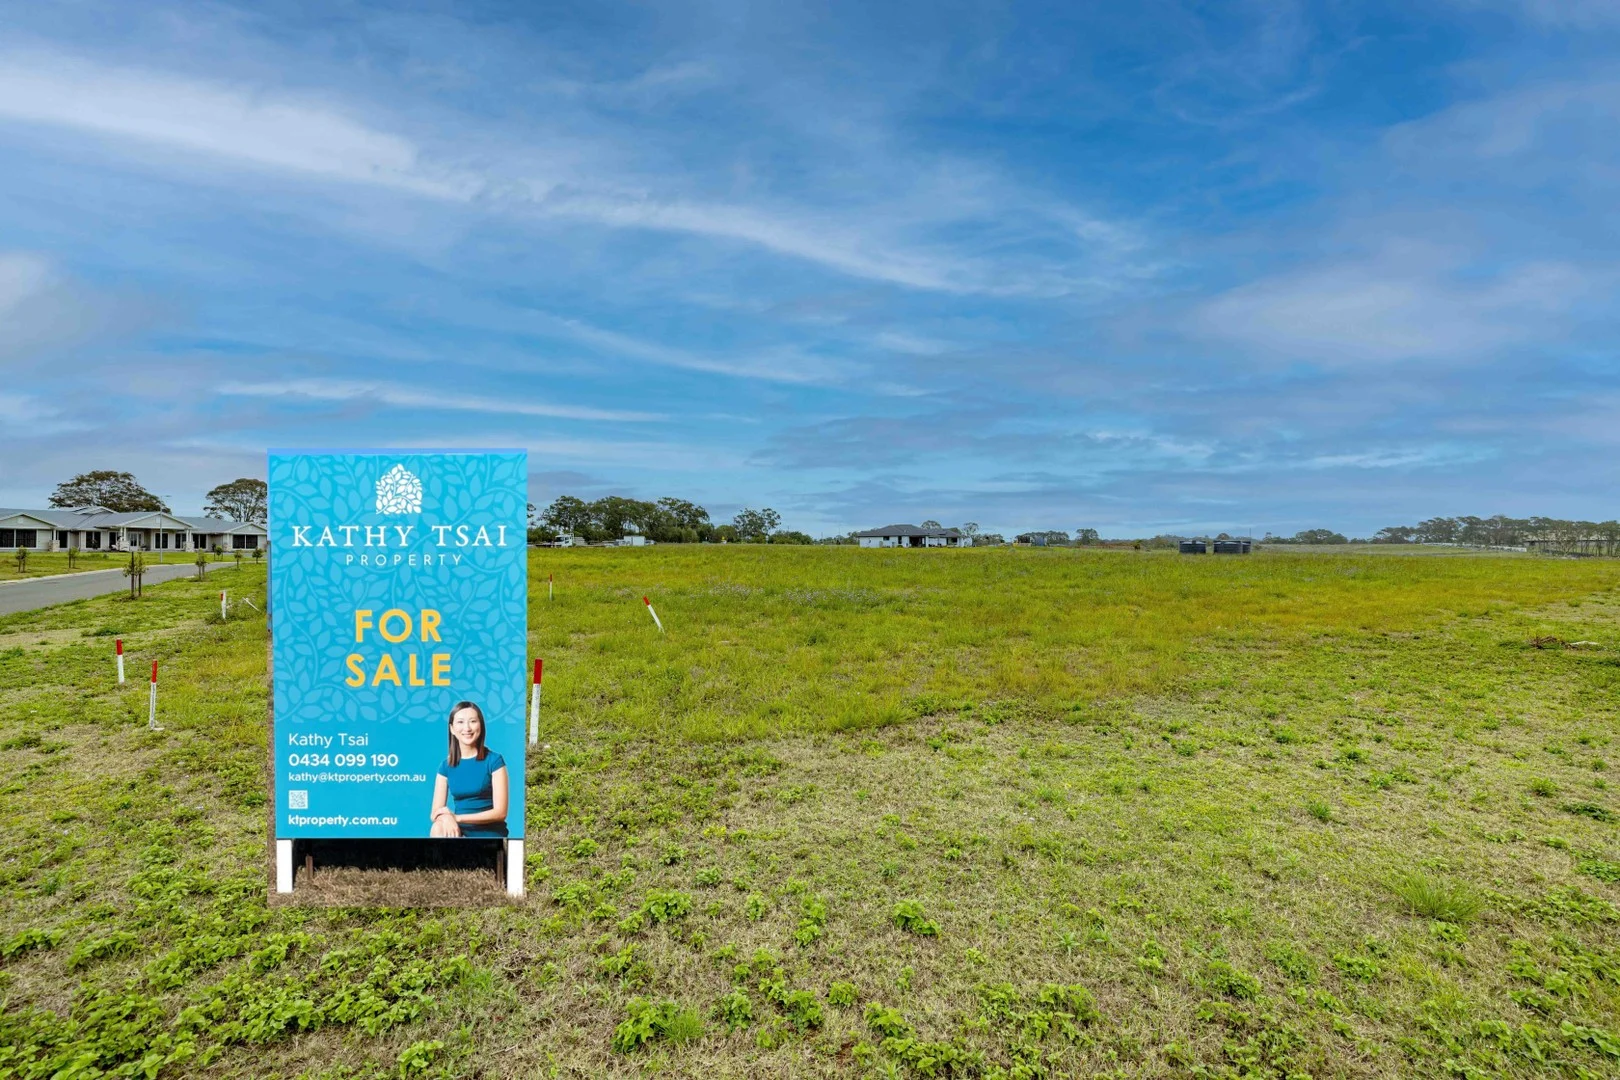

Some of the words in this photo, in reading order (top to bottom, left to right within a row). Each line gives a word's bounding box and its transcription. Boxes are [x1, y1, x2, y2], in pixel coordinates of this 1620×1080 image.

[292, 525, 414, 547] KATHY
[431, 525, 507, 547] TSAI
[346, 554, 462, 566] PROPERTY
[355, 608, 442, 643] FOR
[345, 653, 451, 687] SALE
[288, 733, 333, 748] Kathy
[338, 733, 369, 746] Tsai
[288, 753, 330, 767] 0434
[334, 753, 367, 767] 099
[371, 753, 399, 767] 190
[288, 772, 426, 784] kathy@ktproperty.com.au
[288, 814, 398, 827] ktproperty.com.au
